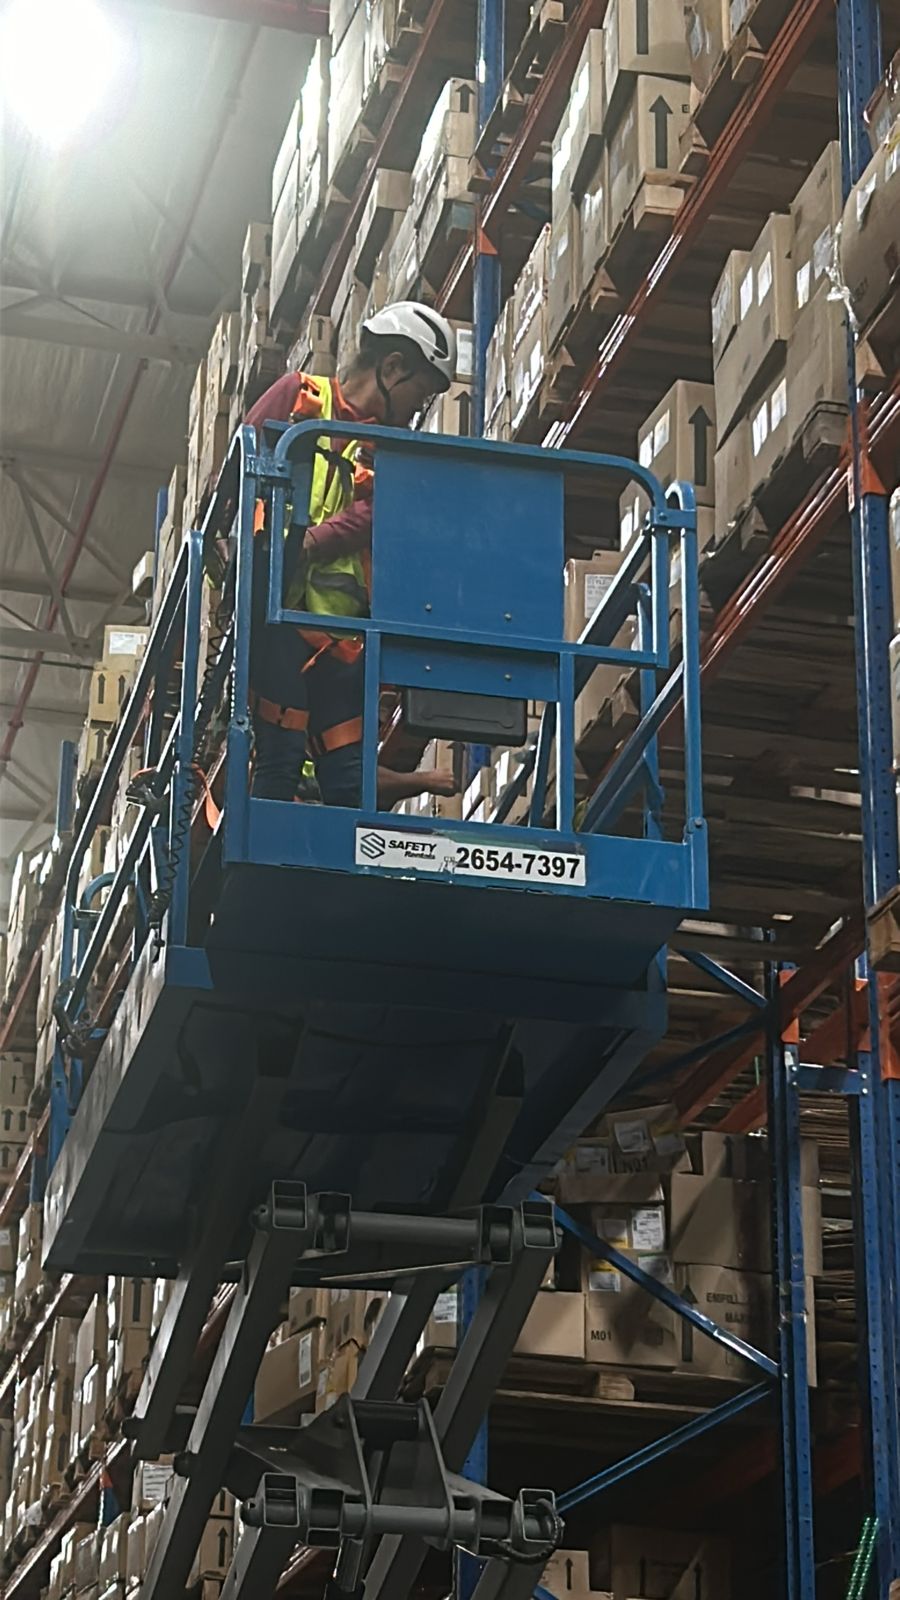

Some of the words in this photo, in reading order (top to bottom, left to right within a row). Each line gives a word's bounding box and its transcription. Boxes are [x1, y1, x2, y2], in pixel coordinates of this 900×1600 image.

[388, 839, 437, 853] SAFETY
[455, 847, 581, 879] 2654-7397
[591, 1330, 612, 1341] M01
